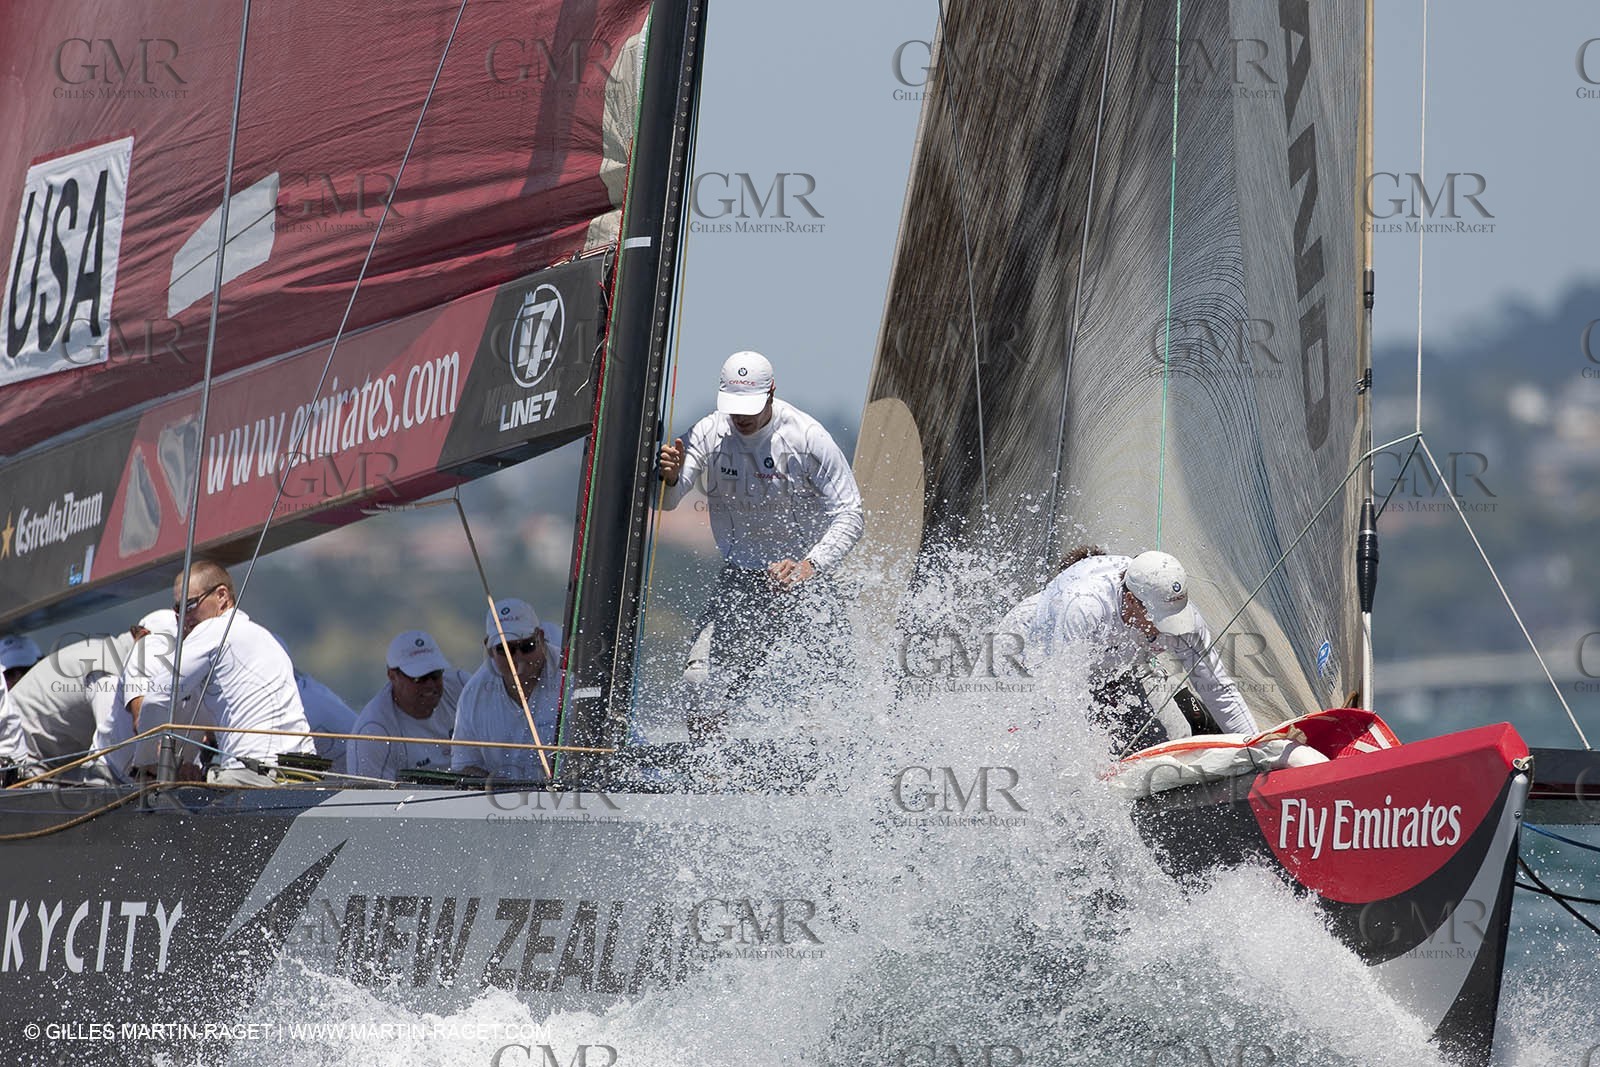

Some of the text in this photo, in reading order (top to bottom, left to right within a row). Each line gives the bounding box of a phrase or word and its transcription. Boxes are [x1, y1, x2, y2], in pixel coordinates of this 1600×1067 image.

[7, 170, 108, 358] USA
[207, 351, 460, 495] www.emirates.com
[1279, 794, 1462, 860] Fly Emirates
[334, 894, 479, 989] NEW
